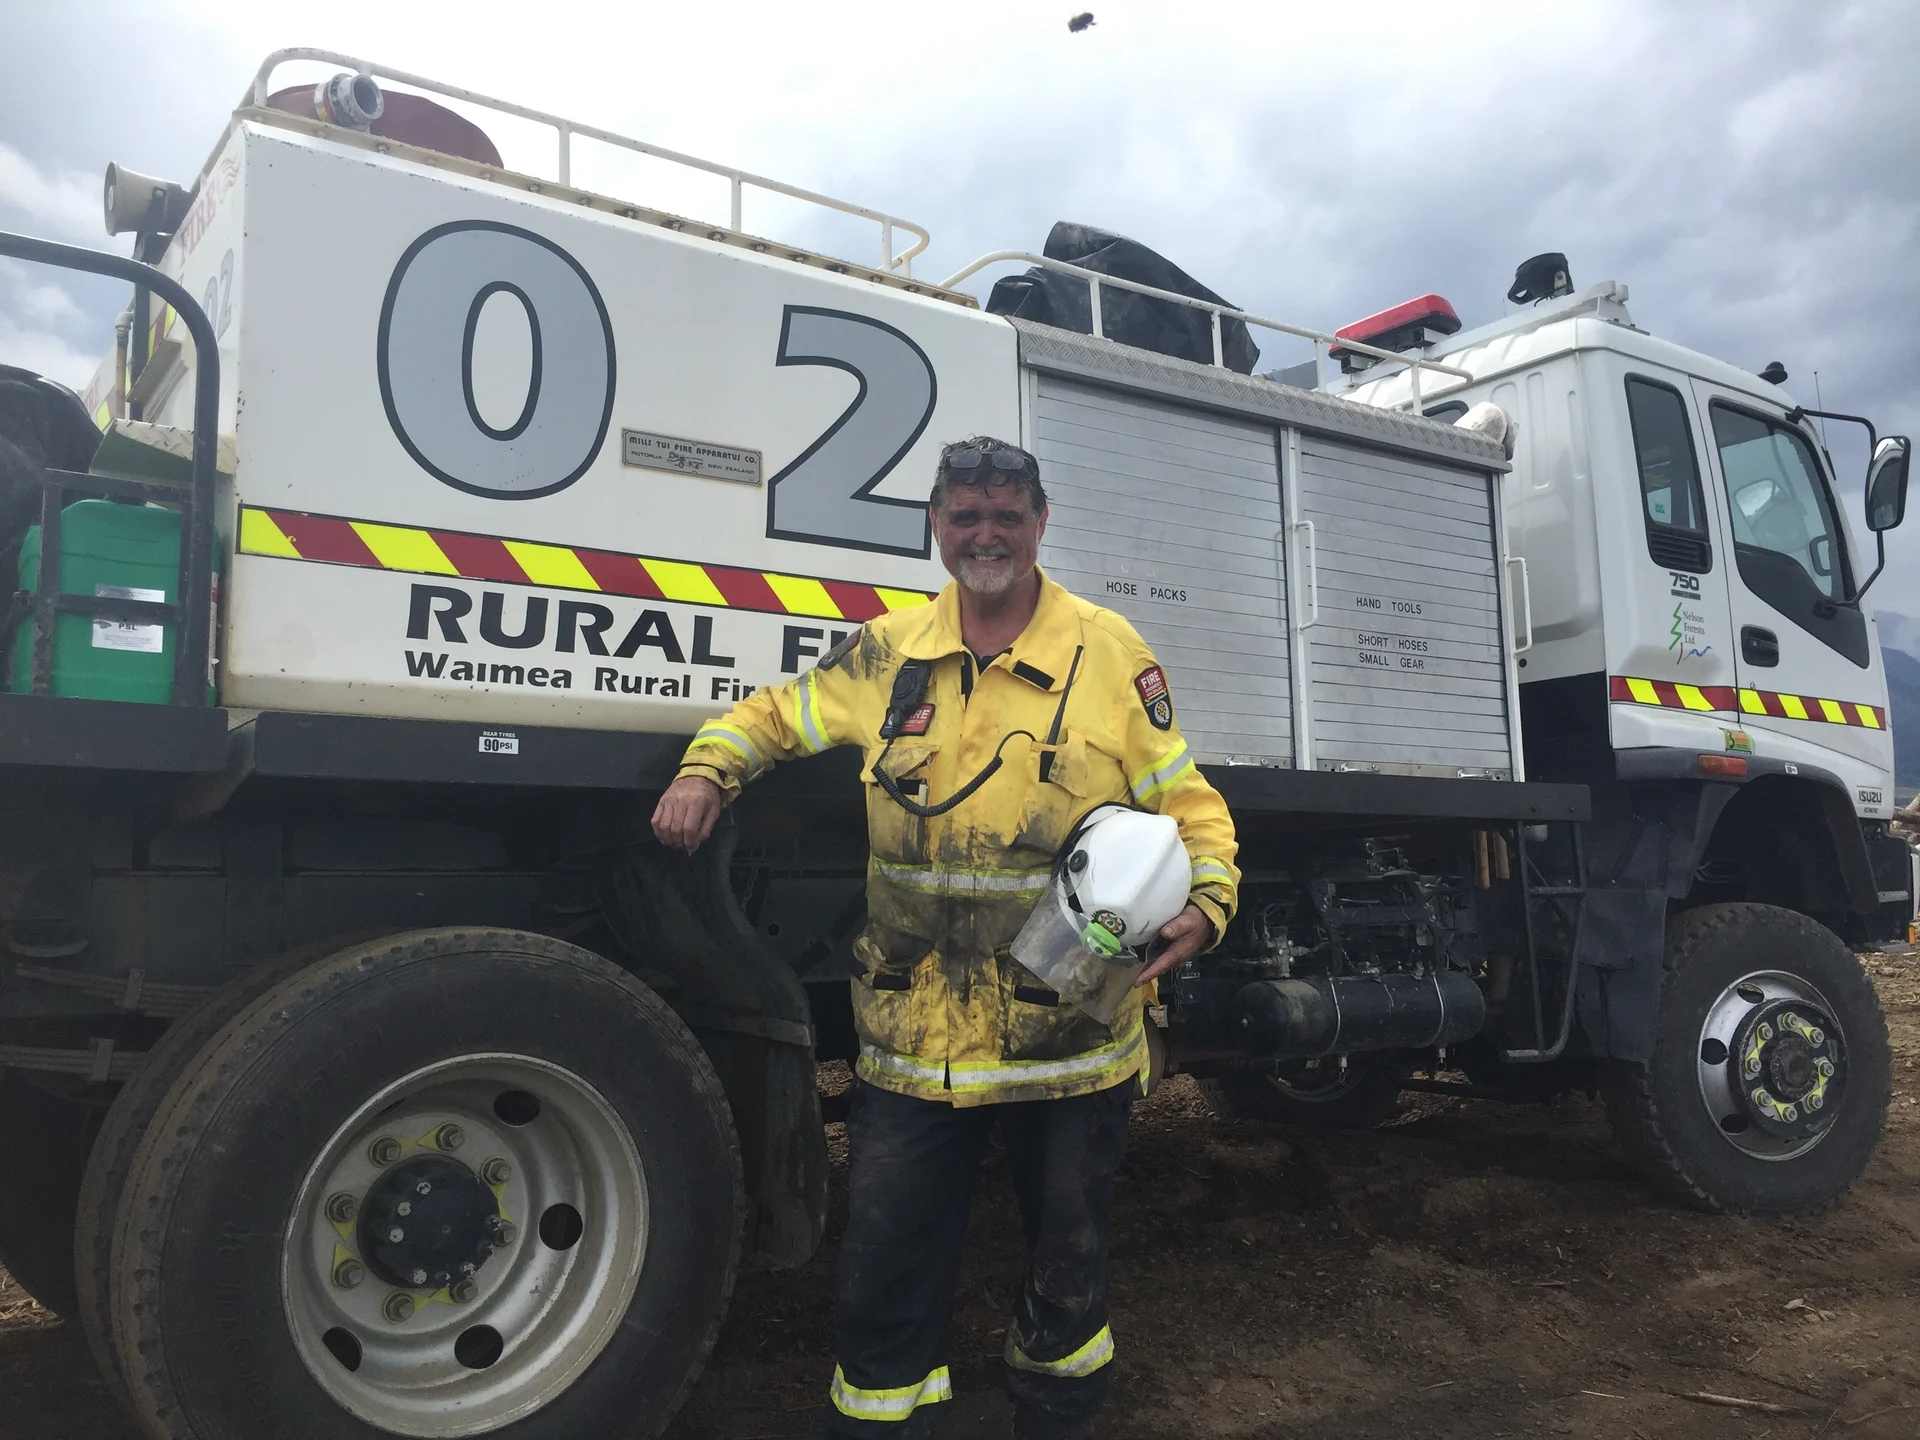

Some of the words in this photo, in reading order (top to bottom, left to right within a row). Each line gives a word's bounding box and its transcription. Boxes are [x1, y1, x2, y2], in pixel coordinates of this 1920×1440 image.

[629, 436, 652, 447] MILLS
[656, 440, 670, 450] TUI
[674, 443, 693, 454] FIRE
[696, 447, 741, 462] APPARATUS
[744, 454, 757, 465] CO.
[631, 450, 663, 460] ROTORUA
[707, 462, 723, 470] NEW
[724, 465, 755, 475] ZEALAND
[1669, 571, 1700, 591] 750
[1106, 581, 1138, 596] HOSE
[1150, 587, 1187, 602] PACKS
[1356, 597, 1382, 609] HAND
[1391, 601, 1422, 614] TOOLS
[406, 583, 736, 668] RURAL
[1683, 611, 1705, 623] Nelson
[1684, 622, 1706, 635] Forests
[1358, 633, 1389, 647] SHORT
[1398, 639, 1428, 652] HOSES
[1359, 652, 1390, 666] SMALL
[1400, 657, 1424, 670] GEAR
[404, 650, 572, 689] Waimea
[594, 667, 691, 698] Rural
[1140, 670, 1161, 689] FIRE
[1858, 790, 1882, 803] ISUZU
